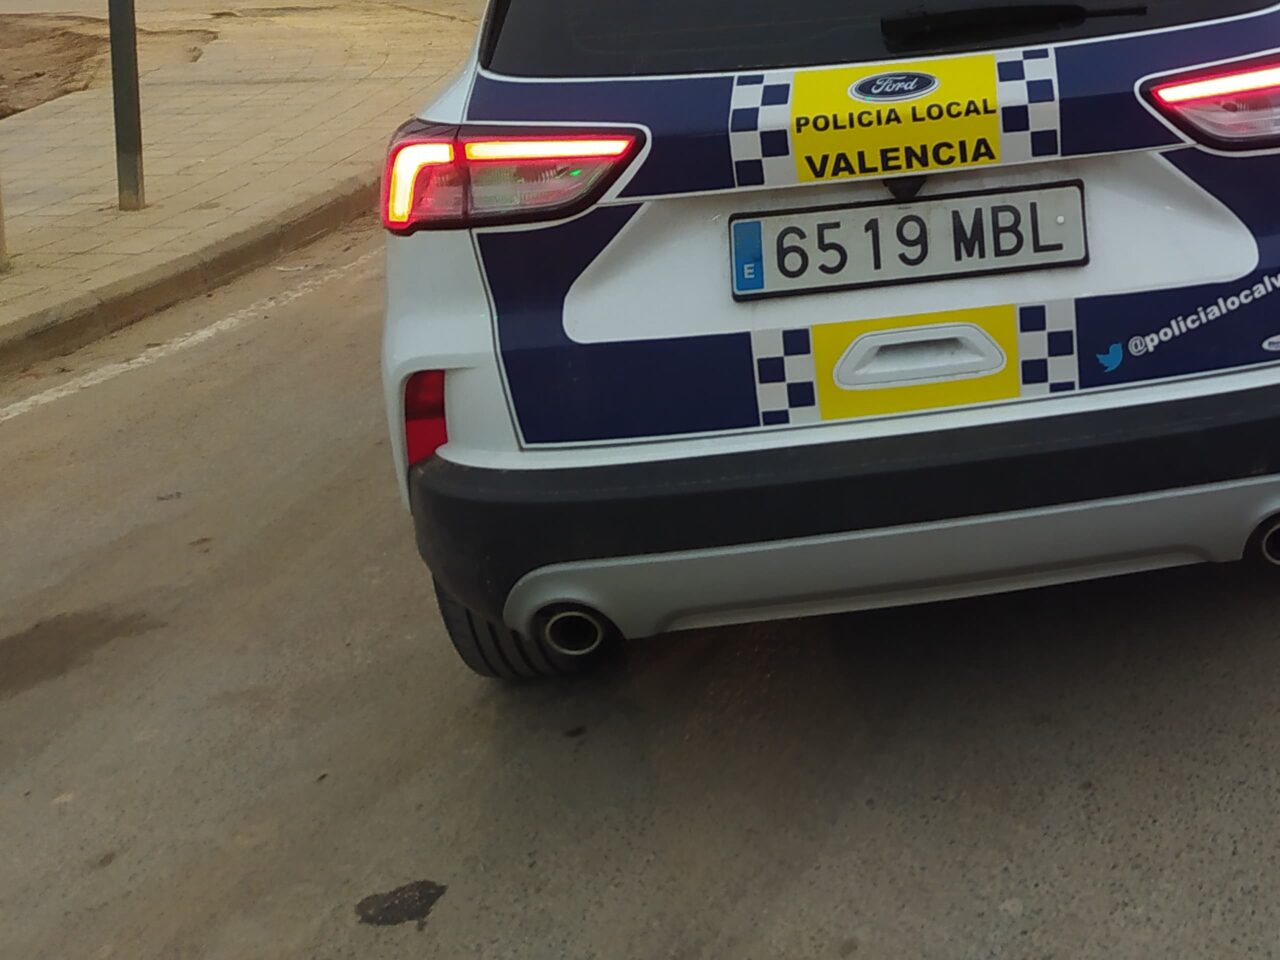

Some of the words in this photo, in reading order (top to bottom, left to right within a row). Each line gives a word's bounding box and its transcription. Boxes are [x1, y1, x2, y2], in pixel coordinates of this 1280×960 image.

[871, 75, 919, 94] Ford
[795, 106, 903, 134] POLICIA
[911, 98, 997, 123] LOCAL
[804, 137, 997, 179] VALENCIA
[743, 263, 756, 279] E
[776, 214, 929, 279] 6519
[951, 201, 1064, 262] MBL
